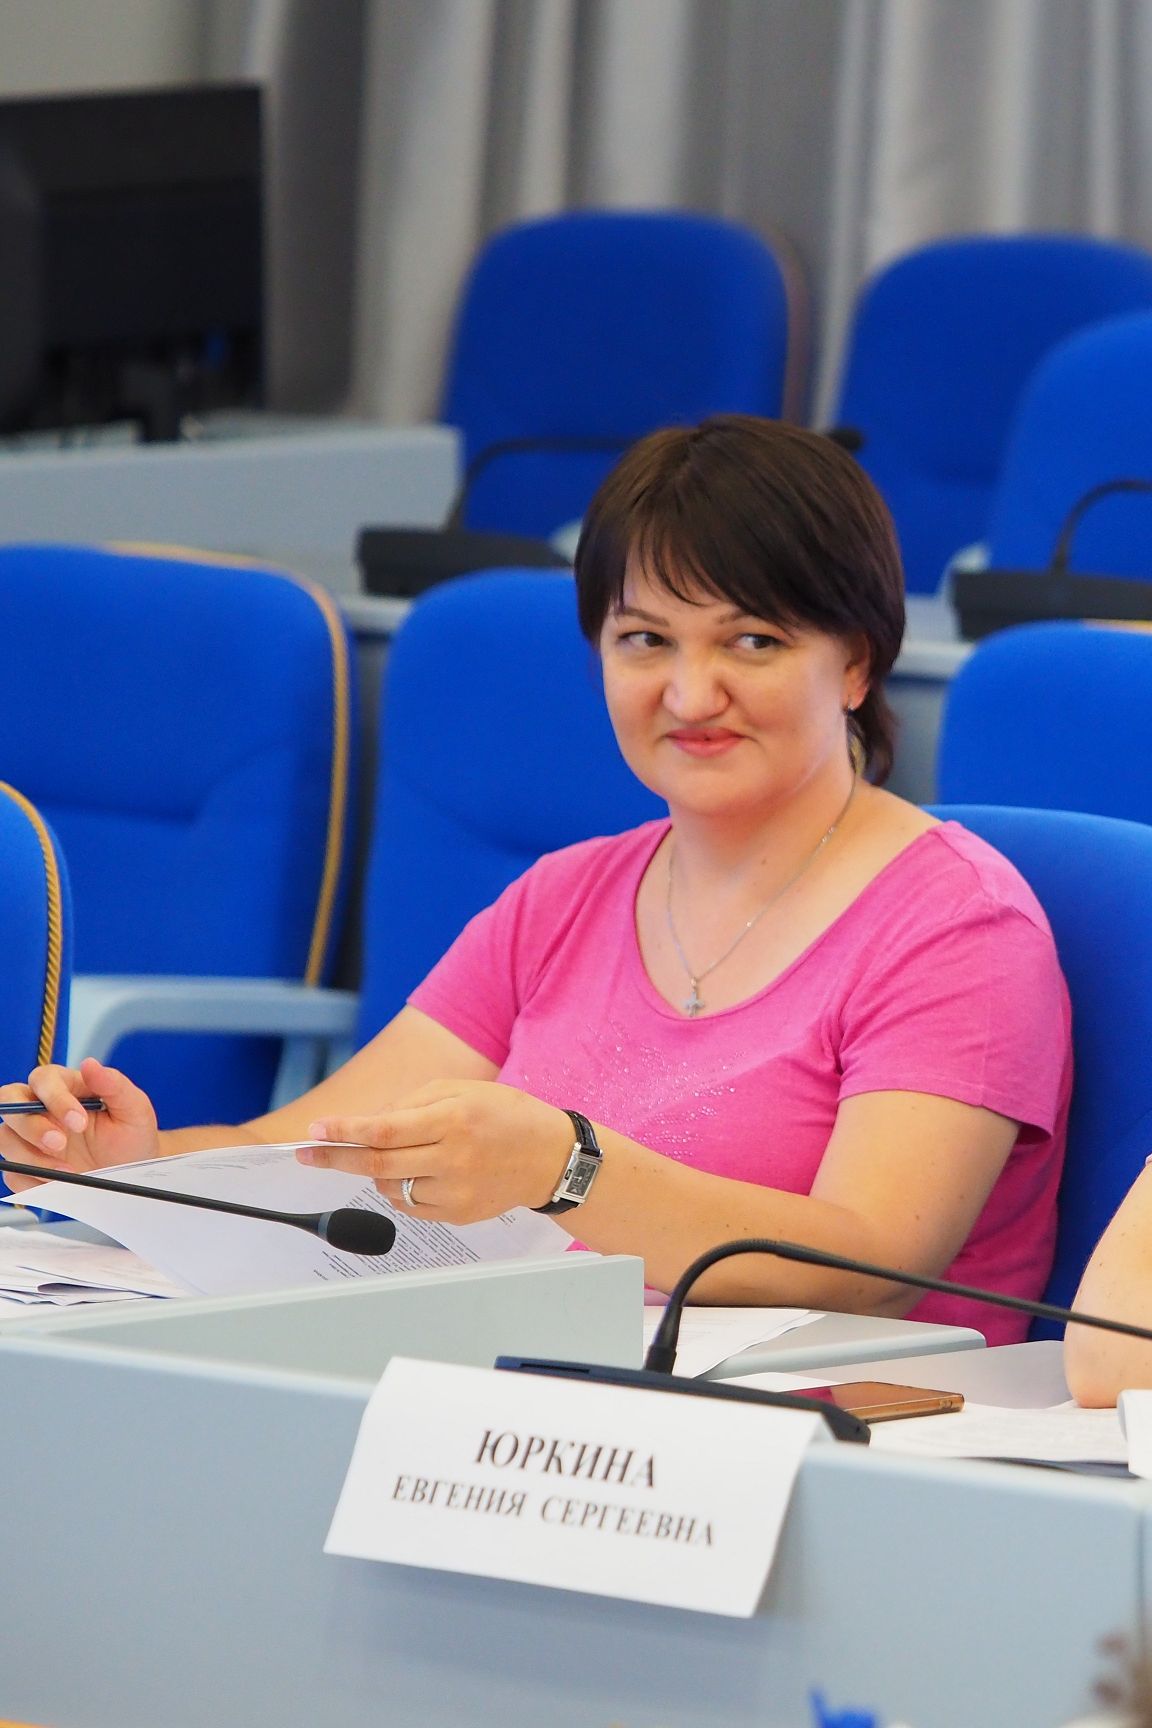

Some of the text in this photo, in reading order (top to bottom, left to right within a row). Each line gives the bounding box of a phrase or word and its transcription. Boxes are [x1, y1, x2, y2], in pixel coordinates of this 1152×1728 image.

[474, 1429, 658, 1489] ЮРКИНА
[391, 1475, 715, 1547] ЕВГЕНИЯ СЕРГЕЕВНА
